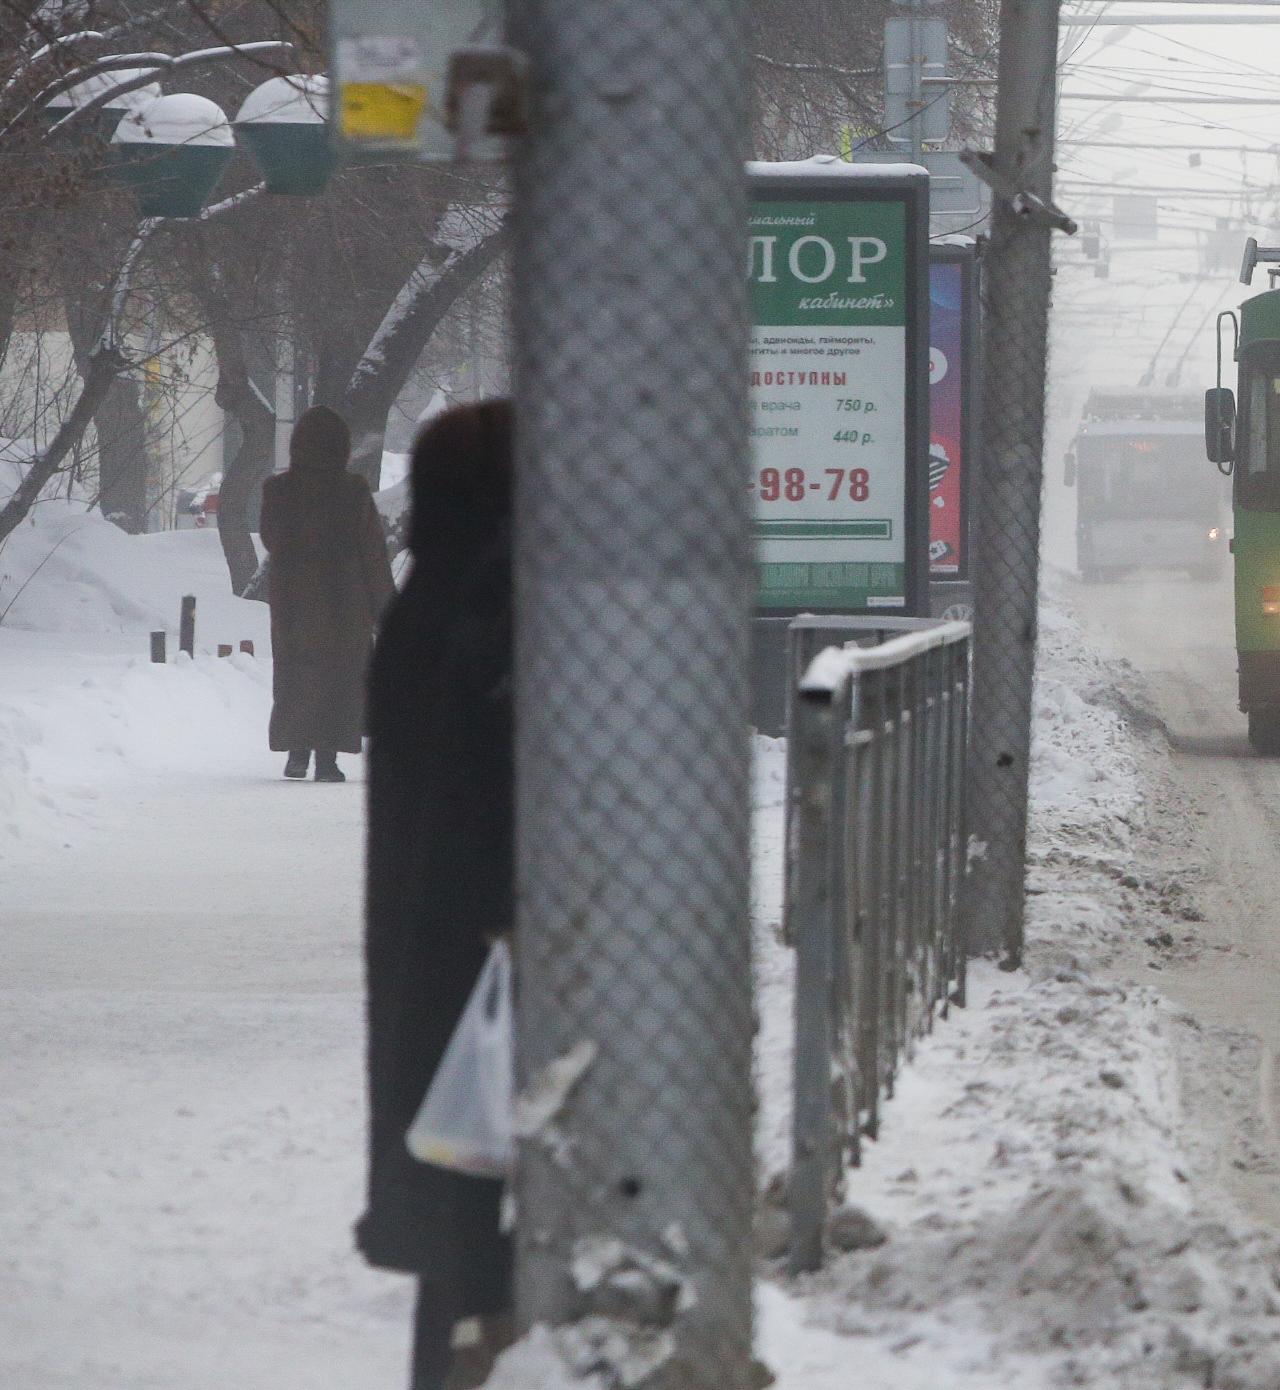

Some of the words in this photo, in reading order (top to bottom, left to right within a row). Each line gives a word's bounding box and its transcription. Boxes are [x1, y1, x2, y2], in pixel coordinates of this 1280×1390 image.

[747, 235, 887, 283] ЛОР
[798, 292, 895, 309] кабинет»
[752, 371, 846, 386] ДОСТУПНЫ
[761, 401, 801, 413] врача
[836, 399, 861, 411] 750
[751, 427, 799, 437] аратом
[833, 430, 859, 442] 440
